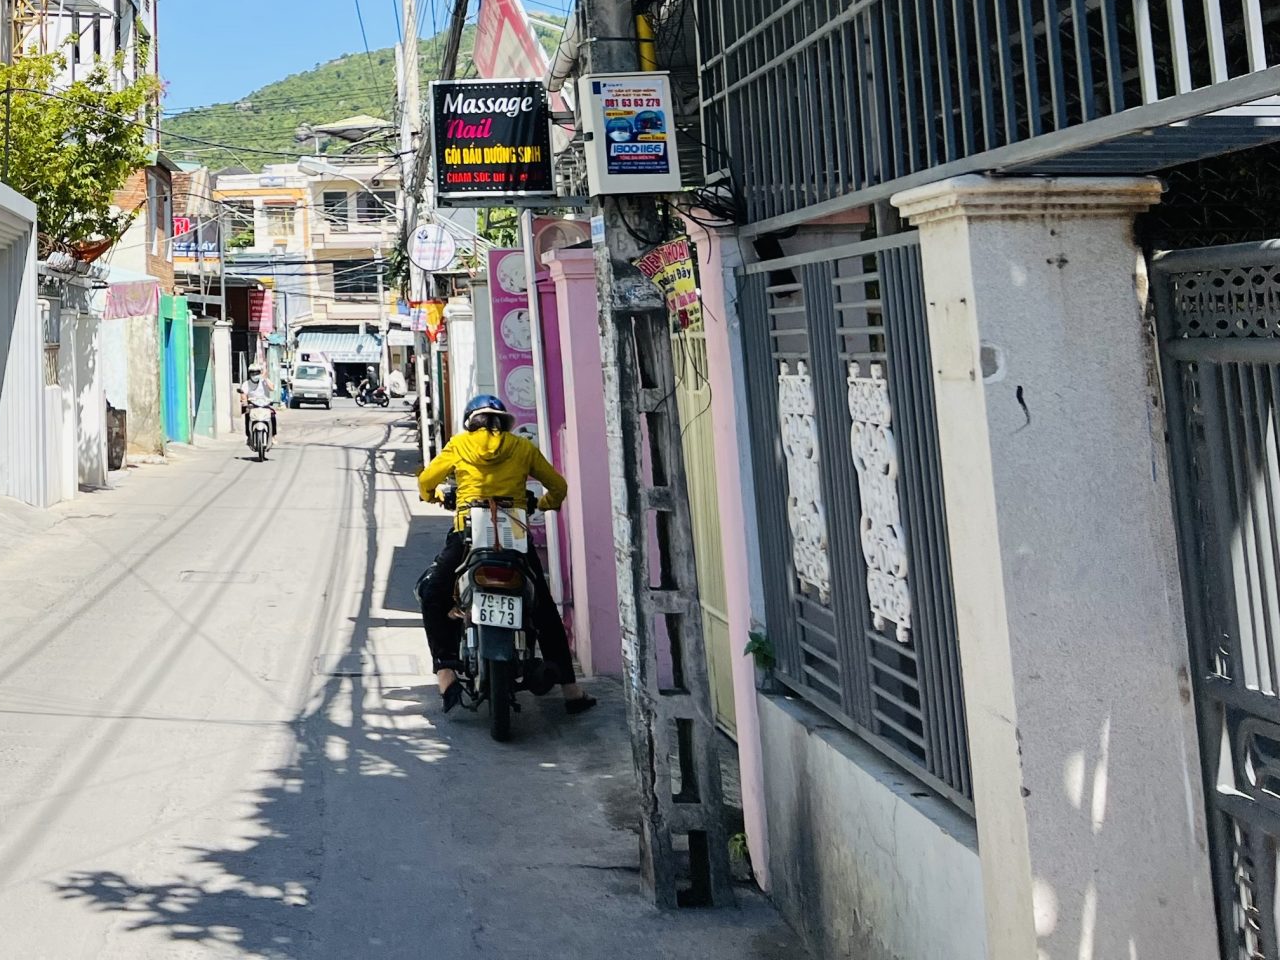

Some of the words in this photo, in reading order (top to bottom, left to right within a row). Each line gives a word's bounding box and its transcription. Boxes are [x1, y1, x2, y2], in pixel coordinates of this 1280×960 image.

[443, 93, 533, 117] Massage
[646, 98, 660, 107] 279
[447, 118, 492, 138] Nail
